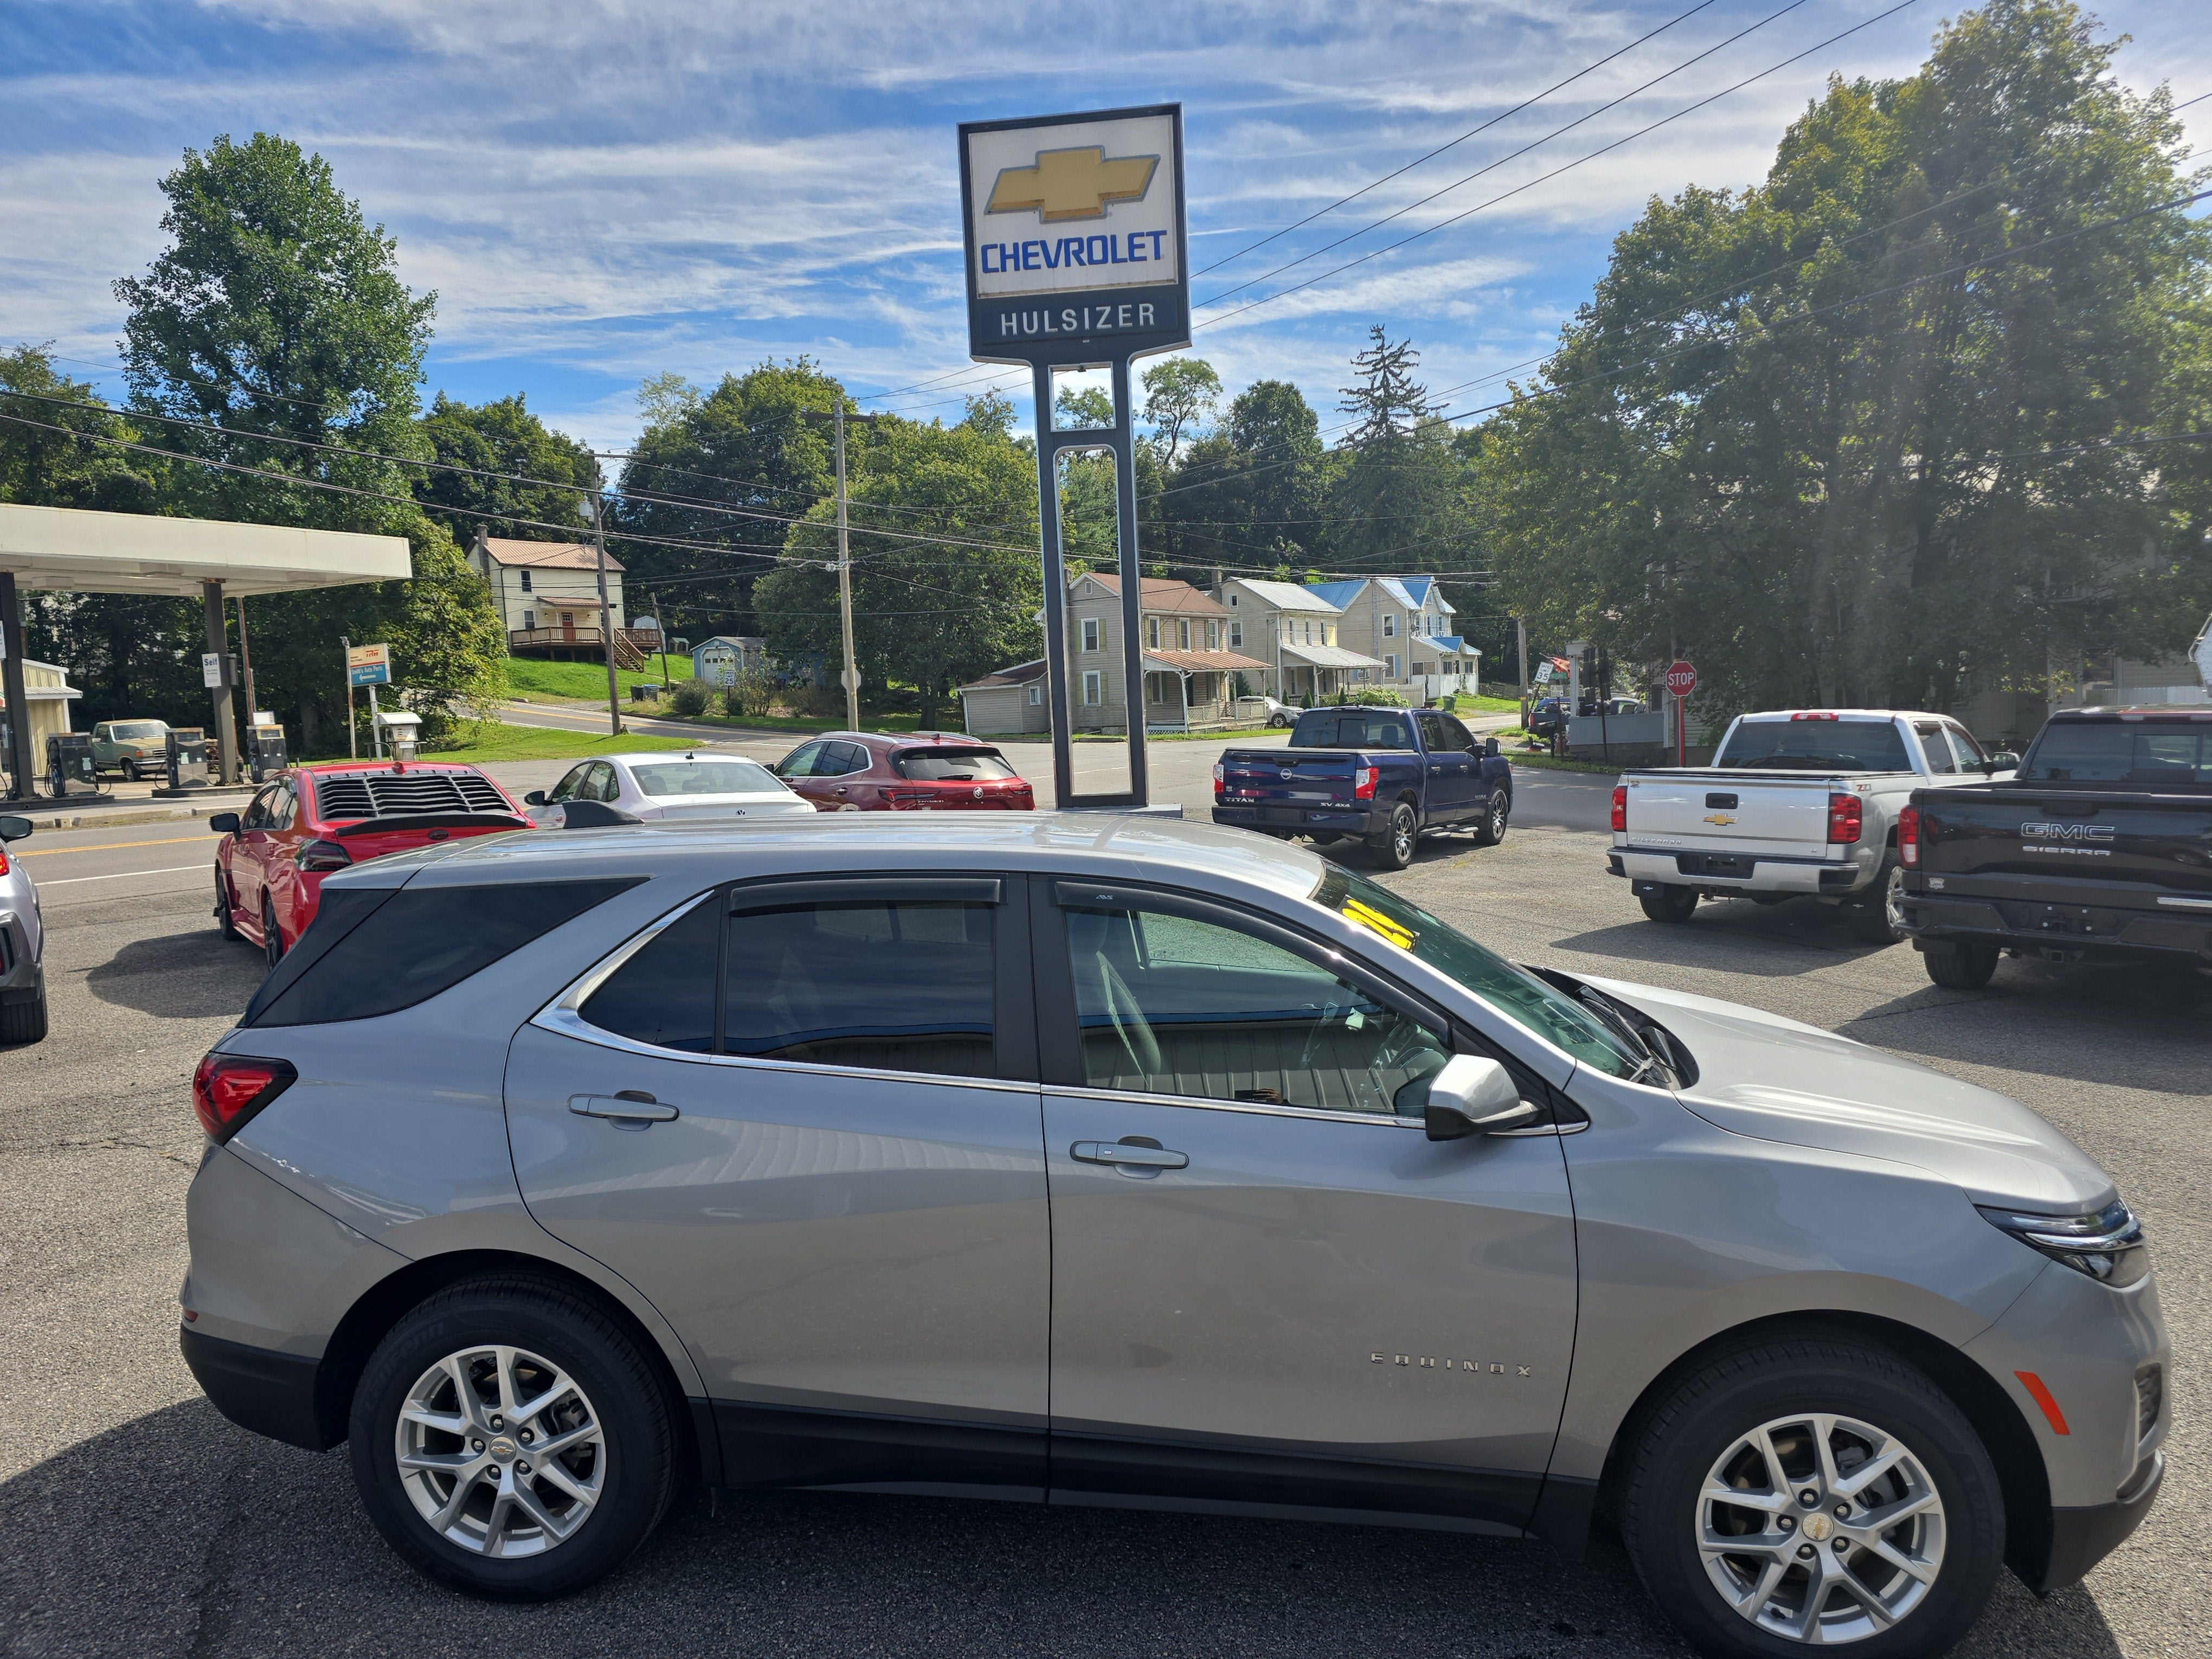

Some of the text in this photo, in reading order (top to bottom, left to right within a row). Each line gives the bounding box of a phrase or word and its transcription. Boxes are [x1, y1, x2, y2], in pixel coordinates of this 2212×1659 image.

[981, 230, 1168, 273] CHEVROLET
[1001, 303, 1155, 336] HULSIZER
[365, 649, 379, 658] TRW
[204, 657, 218, 666] Self
[1537, 672, 1549, 680] 35
[1668, 672, 1694, 686] STOP
[2021, 822, 2115, 841] GMC
[1631, 837, 1682, 845] SILVERADO
[2022, 845, 2112, 857] SIERRA
[1370, 1351, 1532, 1378] EQUINOX
